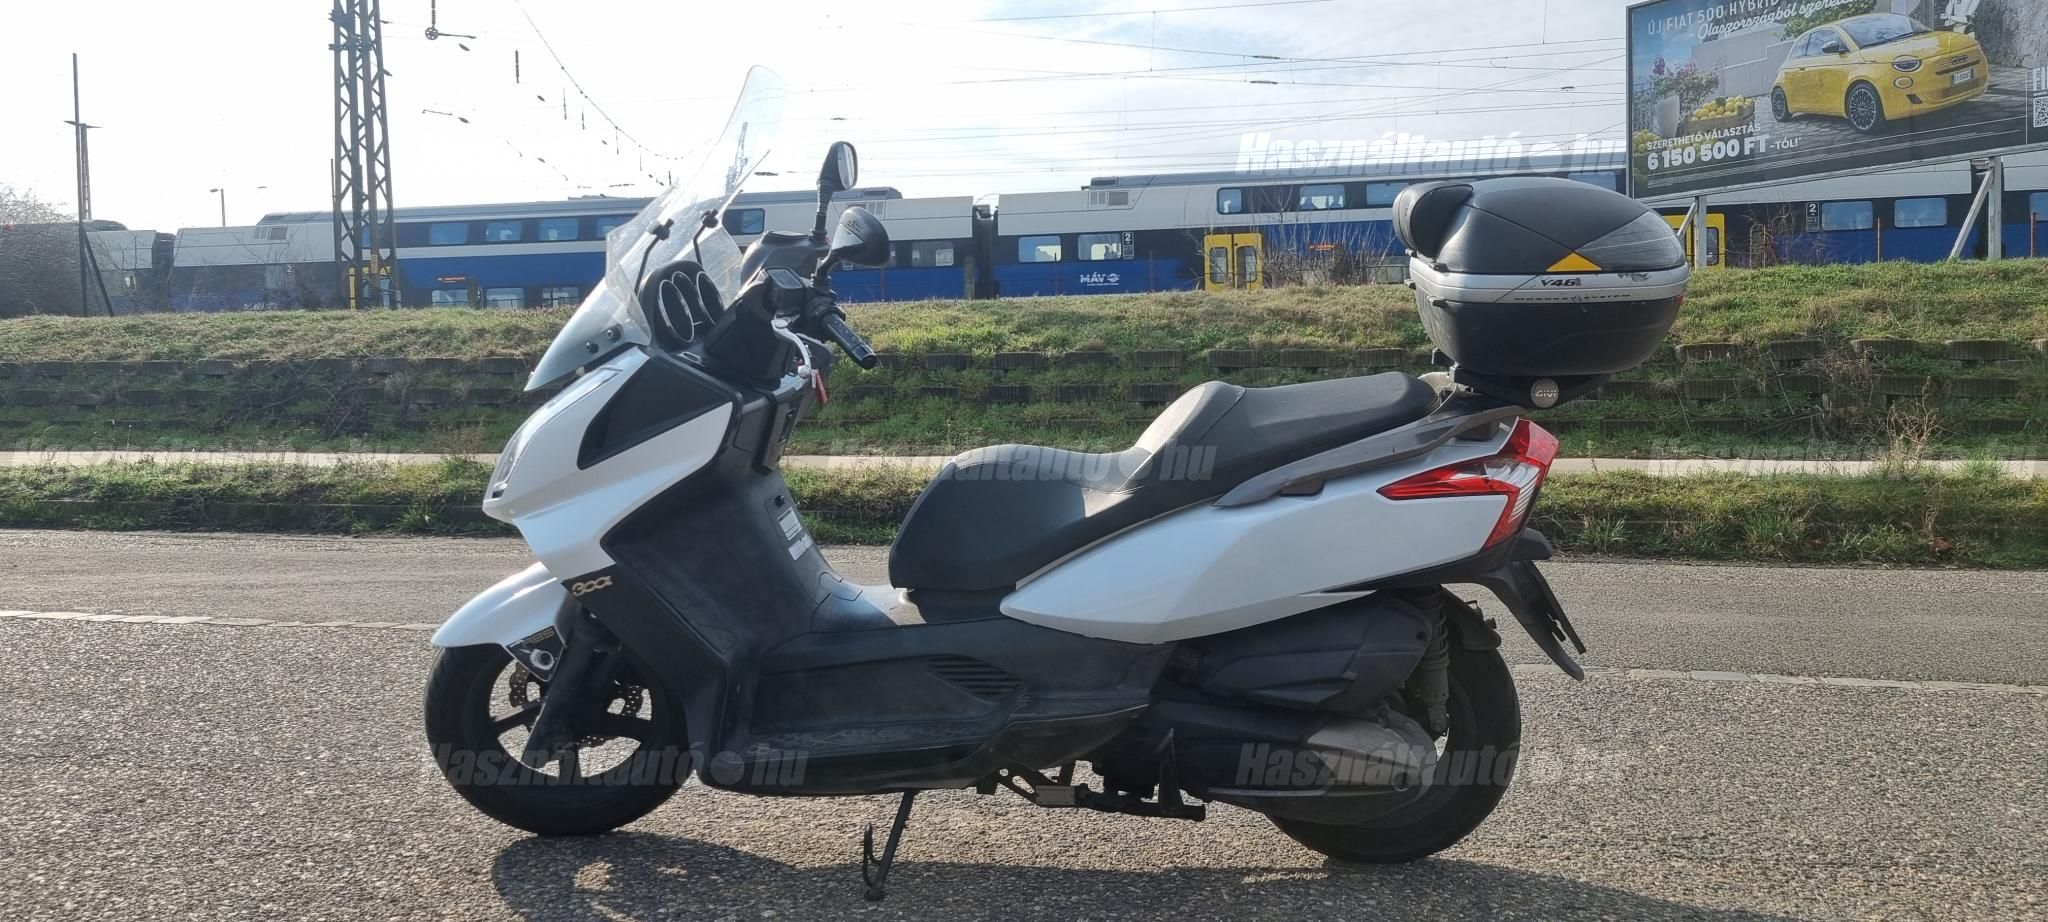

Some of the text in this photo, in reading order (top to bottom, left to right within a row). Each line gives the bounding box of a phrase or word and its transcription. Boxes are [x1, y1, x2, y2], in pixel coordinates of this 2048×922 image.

[1647, 19, 1662, 36] ÚJ
[1666, 12, 1693, 31] FIAT
[1697, 5, 1724, 24] 500
[1647, 121, 1761, 151] SZERETHETŐ VÁLASZTÁS
[1647, 154, 1659, 170] 6
[1662, 146, 1696, 168] 150
[1700, 138, 1740, 162] 500
[1744, 134, 1770, 156] FT
